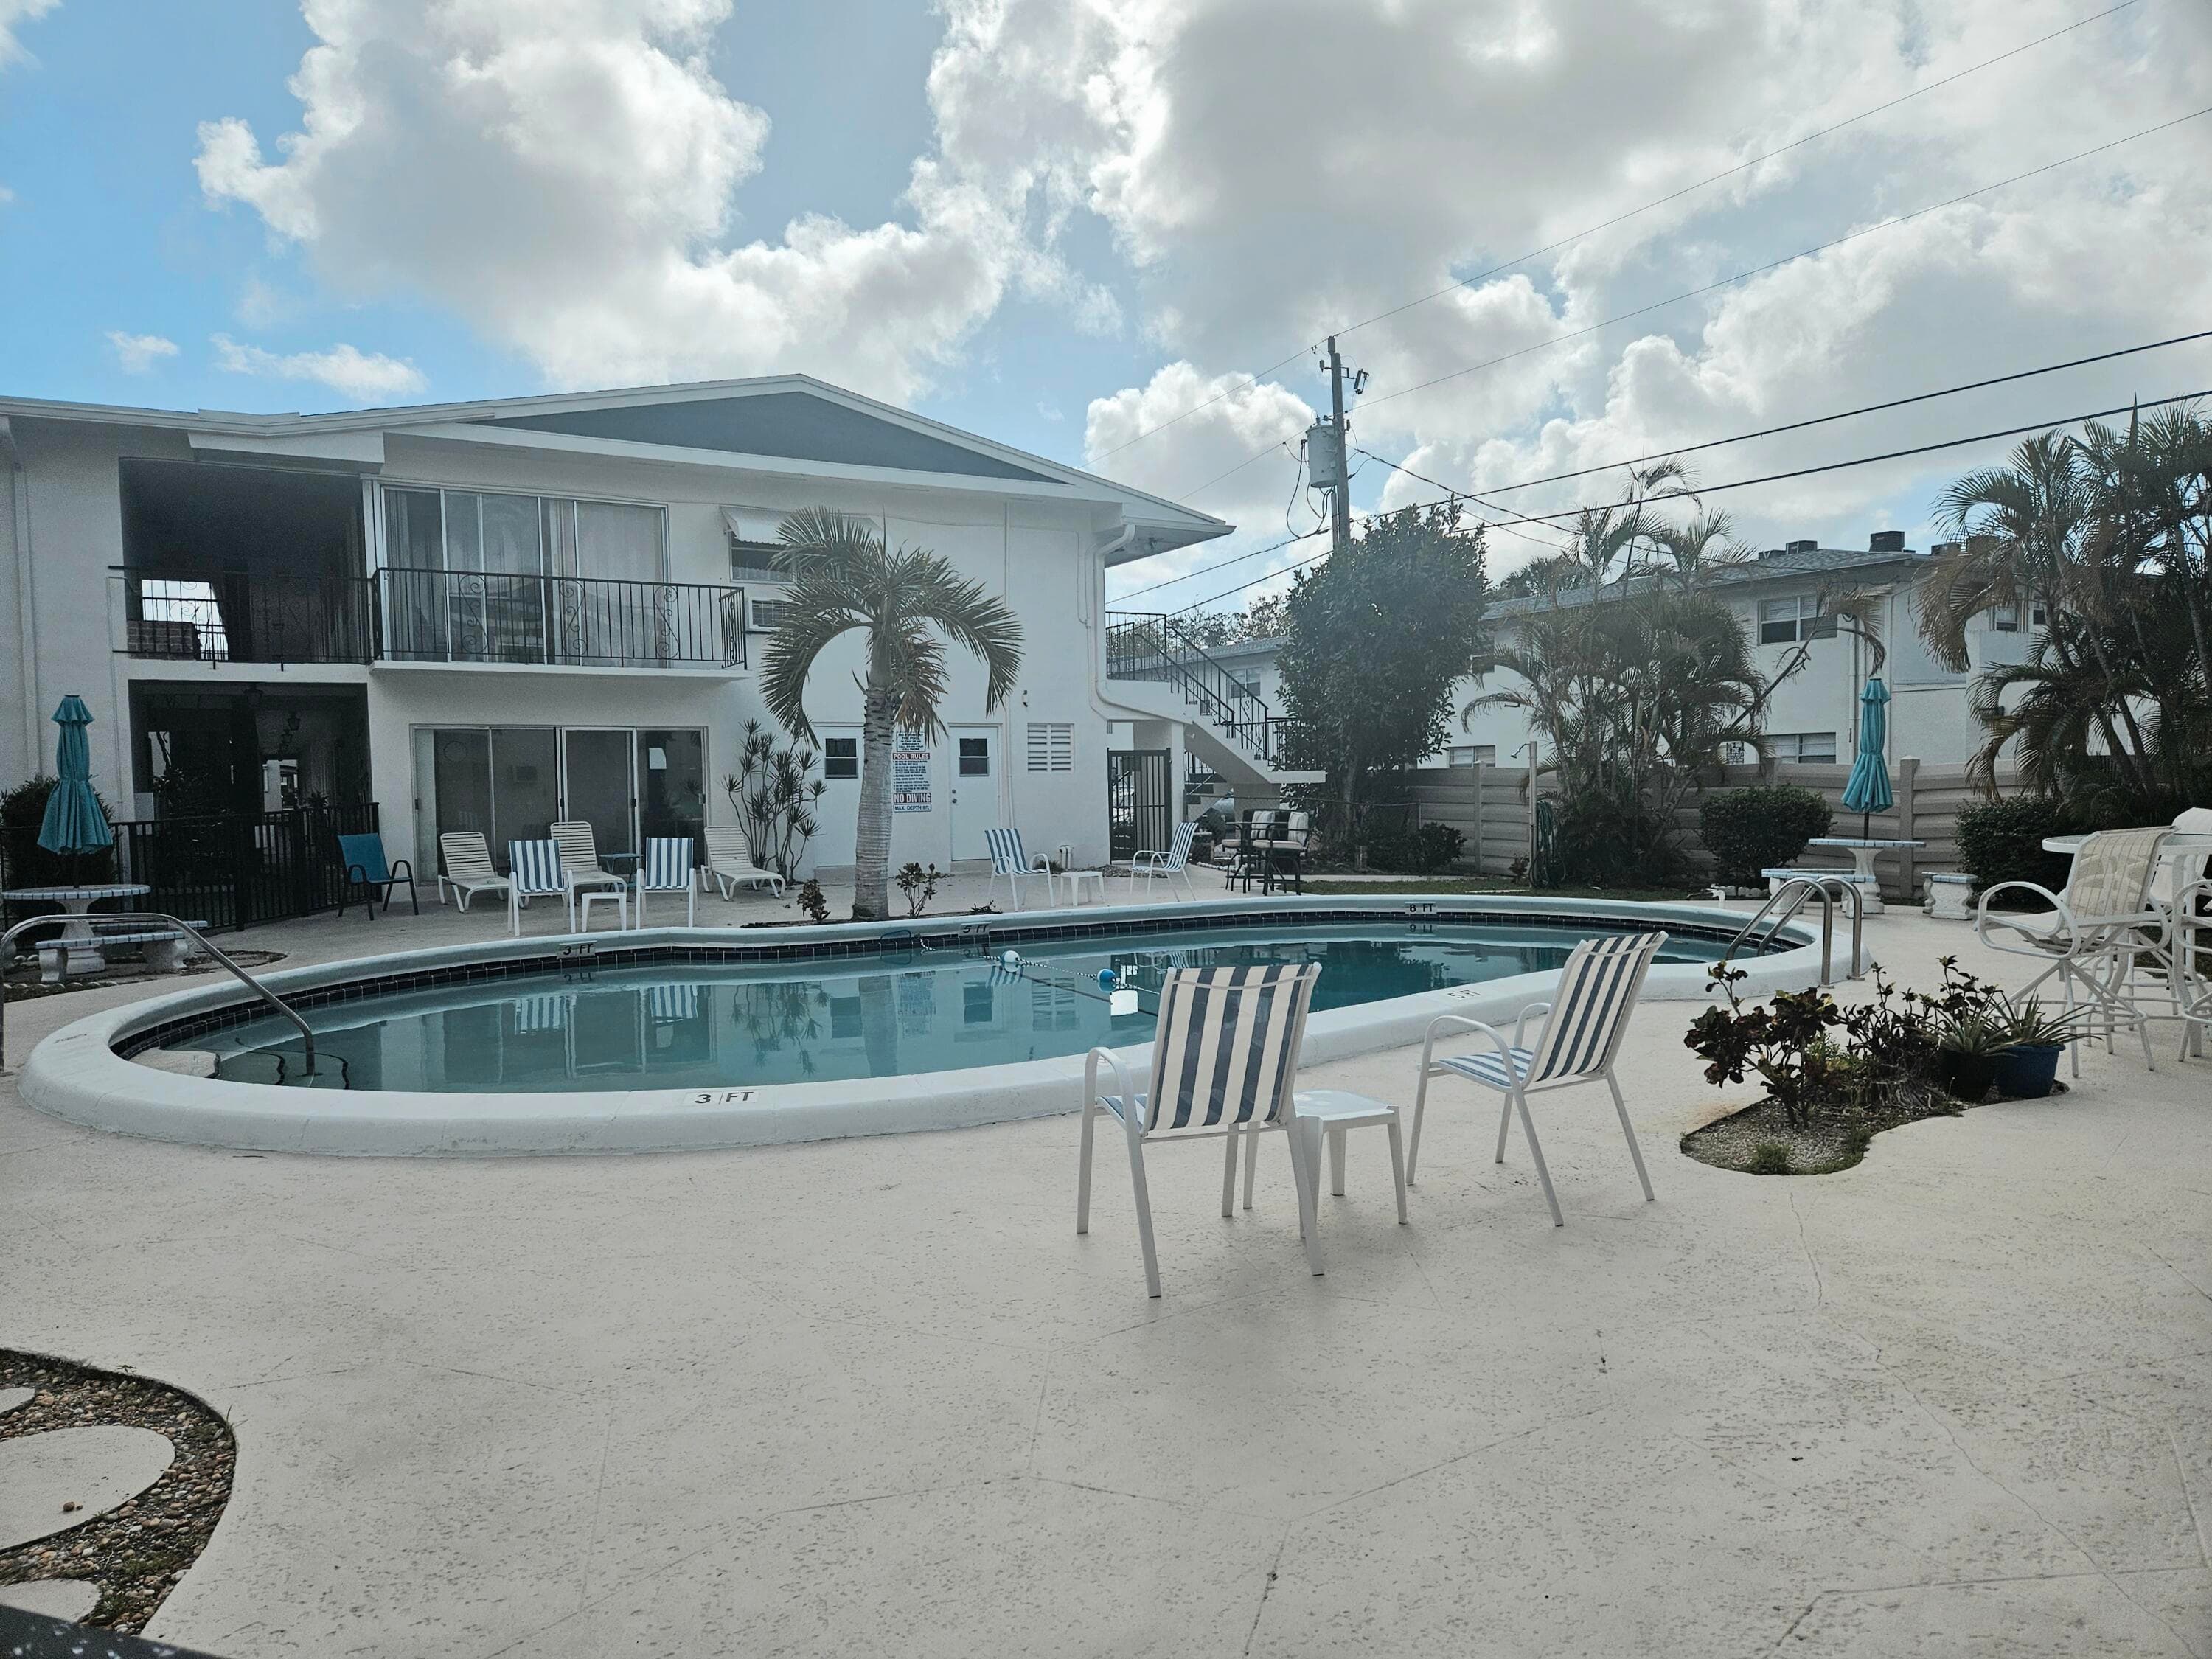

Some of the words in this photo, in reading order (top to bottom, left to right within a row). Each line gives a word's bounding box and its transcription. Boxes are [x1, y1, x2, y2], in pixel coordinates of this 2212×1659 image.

[894, 794, 905, 803] NO
[907, 793, 931, 803] DIVING
[1409, 904, 1416, 913] 8
[1422, 903, 1433, 913] FT
[962, 925, 973, 933] 5
[563, 945, 572, 956] 3
[579, 943, 594, 954] FT
[694, 1093, 712, 1104] 3
[725, 1091, 754, 1102] FT
